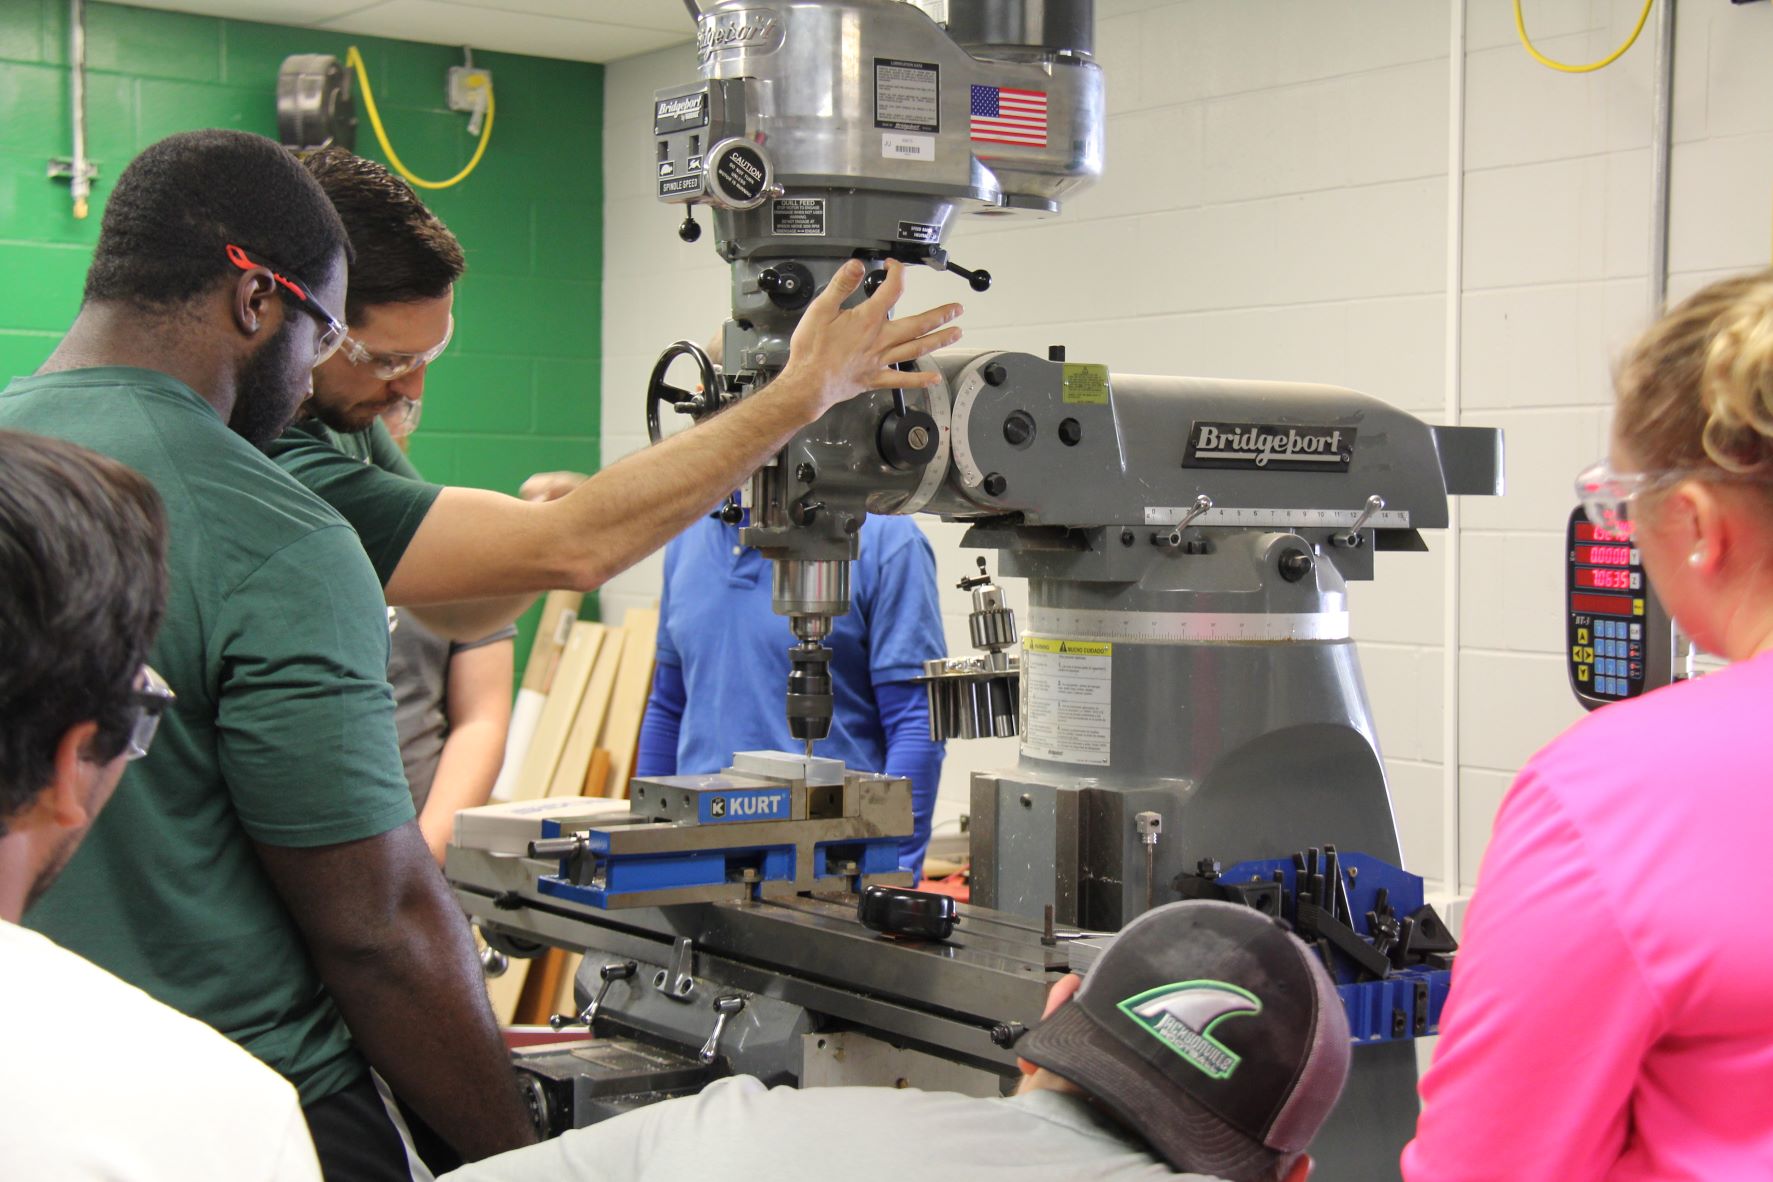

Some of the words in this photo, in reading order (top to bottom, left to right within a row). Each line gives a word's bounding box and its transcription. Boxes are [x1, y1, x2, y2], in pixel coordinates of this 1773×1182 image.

[658, 95, 702, 118] Bridgeport
[732, 152, 762, 179] CAUTION
[663, 181, 682, 192] SPINDLE
[683, 179, 698, 189] SPEED
[1195, 426, 1342, 467] Bridgeport
[730, 795, 781, 816] KURT
[1153, 1012, 1232, 1072] JACKSONVILLE
